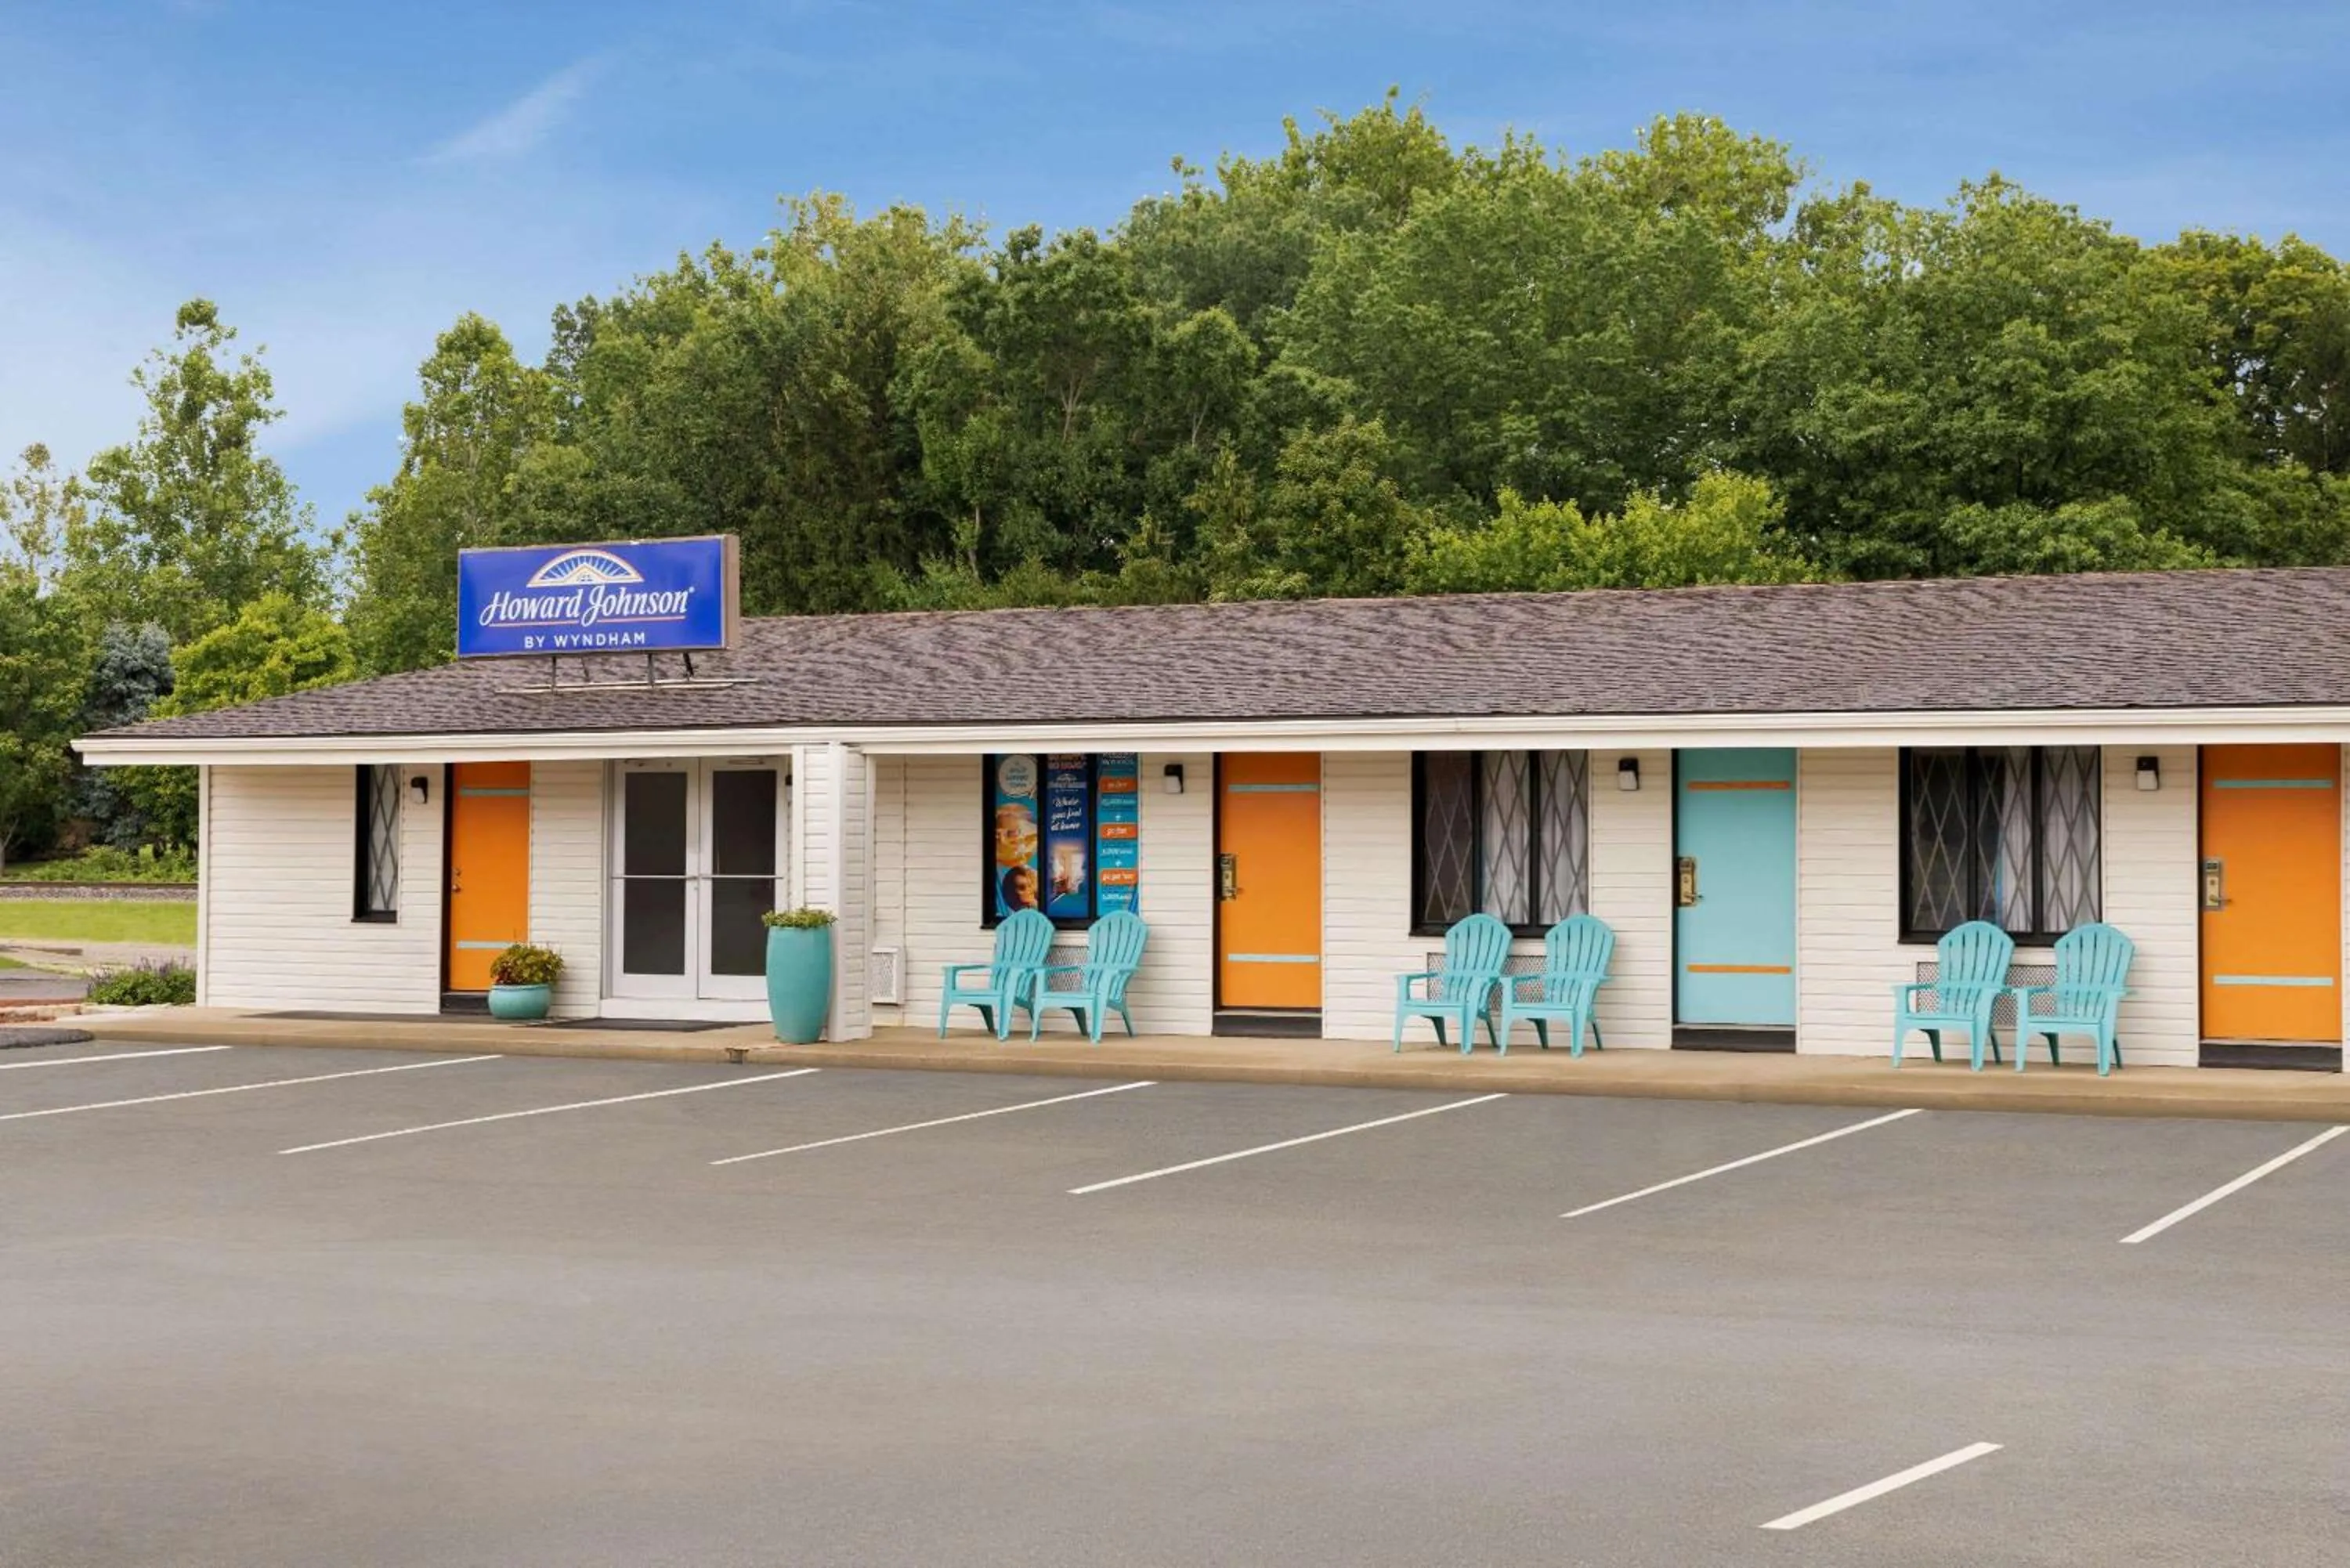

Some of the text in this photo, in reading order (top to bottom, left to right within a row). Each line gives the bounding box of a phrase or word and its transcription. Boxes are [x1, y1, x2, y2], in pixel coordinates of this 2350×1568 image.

[479, 584, 689, 627] Howard Johnson
[524, 632, 646, 649] BY WYNDHAM
